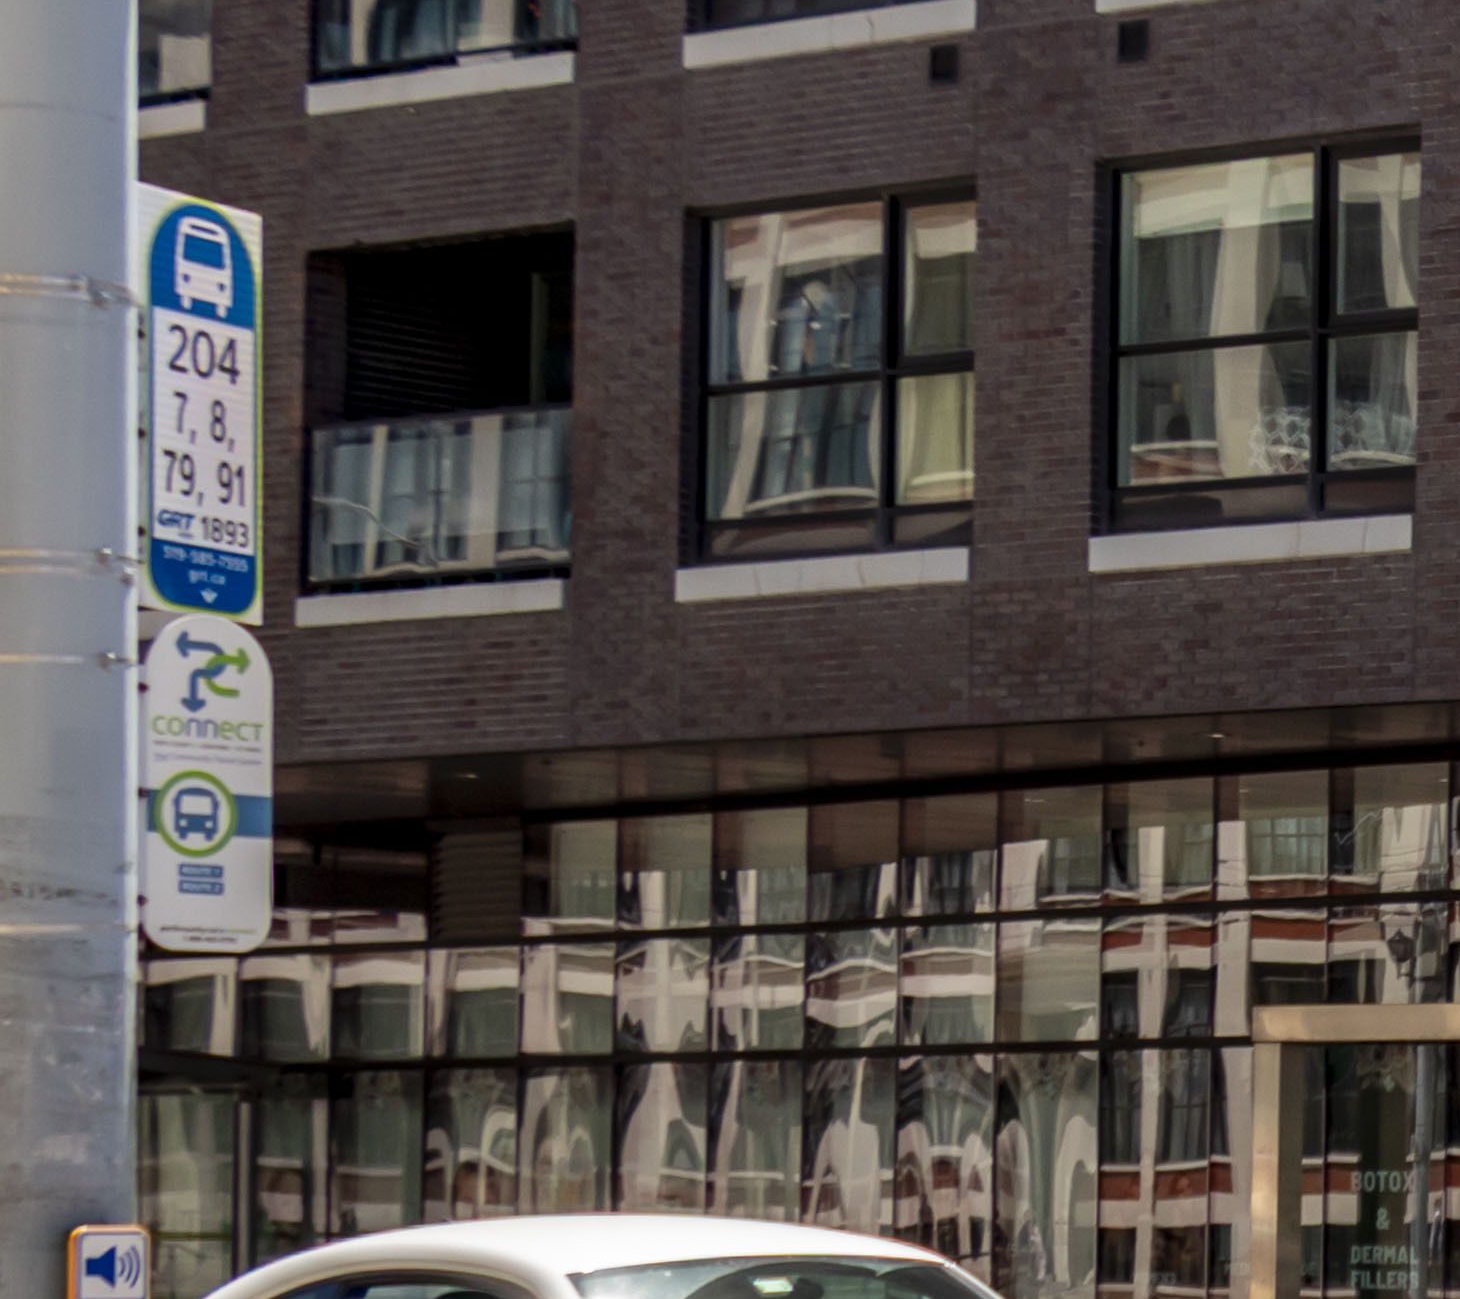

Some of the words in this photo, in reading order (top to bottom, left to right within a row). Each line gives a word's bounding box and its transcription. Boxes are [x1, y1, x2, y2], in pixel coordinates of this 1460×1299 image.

[167, 324, 240, 386] 204
[173, 391, 197, 445] 7,
[210, 400, 235, 453] 8,
[161, 448, 204, 506] 79,
[216, 461, 246, 507] 91
[156, 509, 197, 533] GRT
[200, 515, 250, 549] 1893
[1350, 1171, 1413, 1193] BOTOX
[1375, 1206, 1391, 1231] &
[1351, 1245, 1420, 1265] DERMAL
[1350, 1269, 1420, 1290] FILLERS
